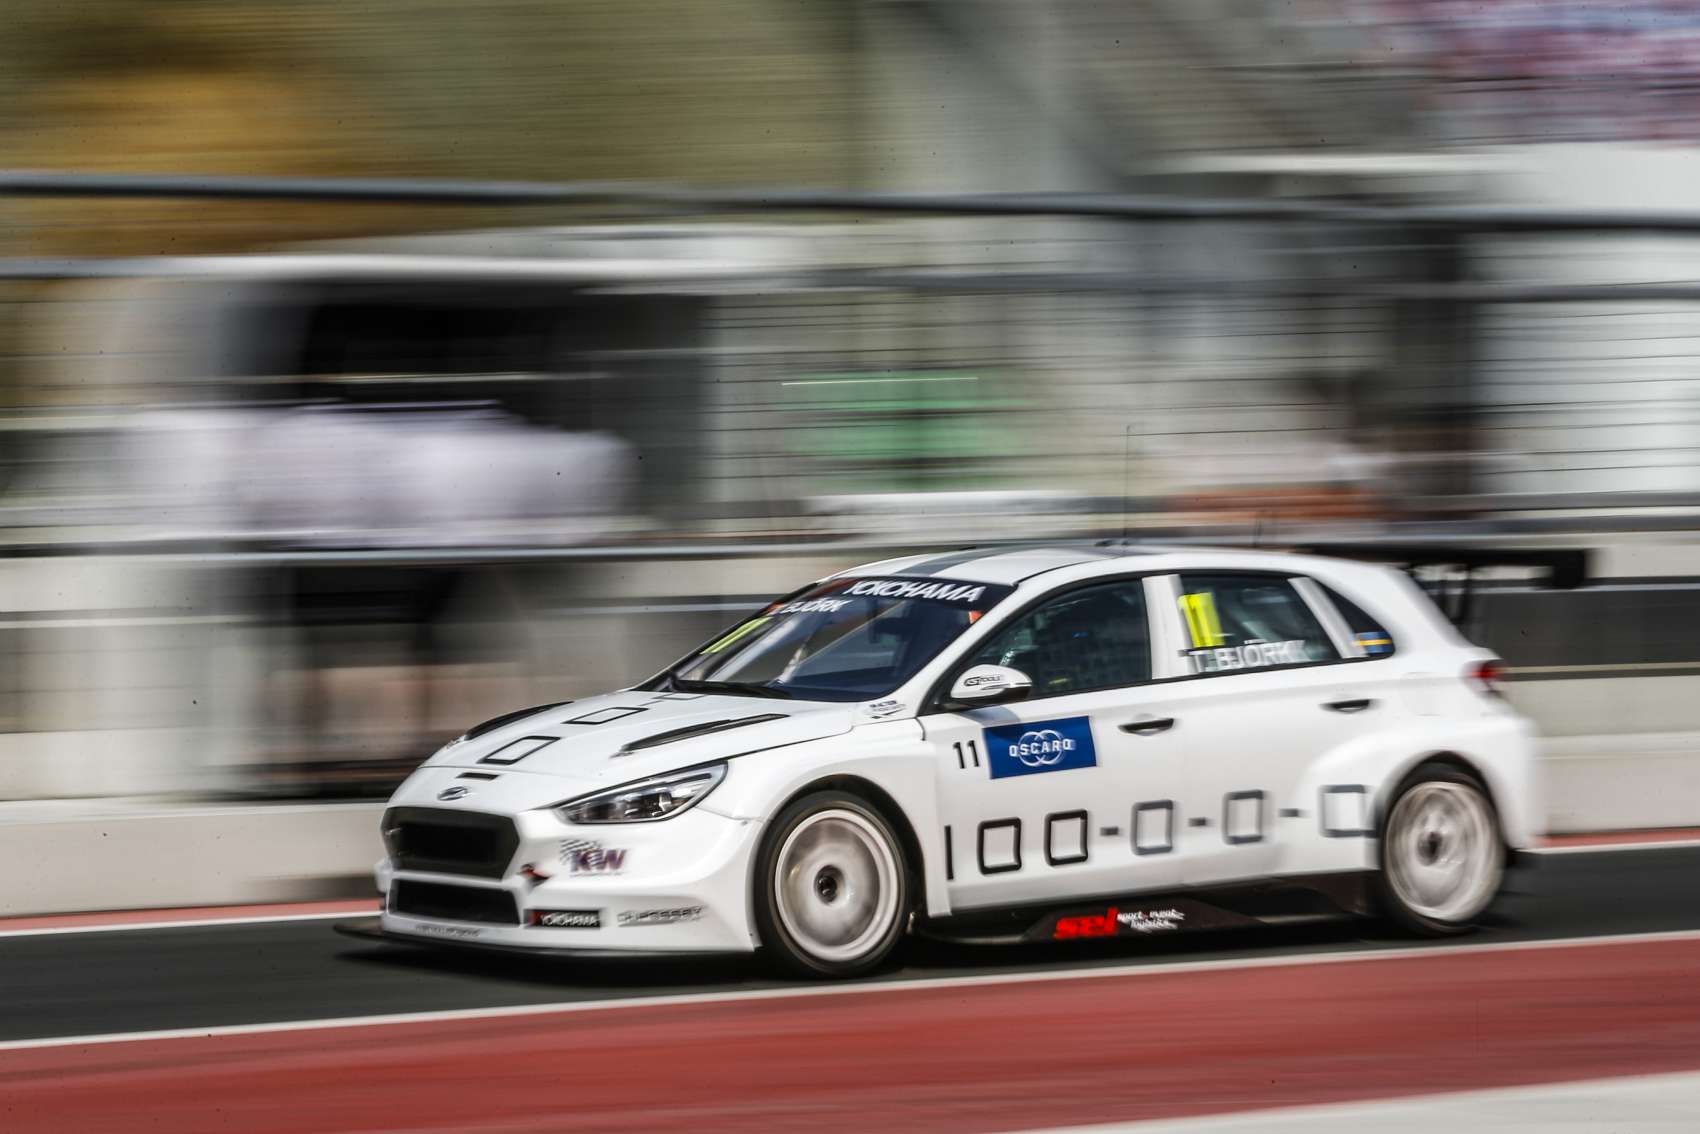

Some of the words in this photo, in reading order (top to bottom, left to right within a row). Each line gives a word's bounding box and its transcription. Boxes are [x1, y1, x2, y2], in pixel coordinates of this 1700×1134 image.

[843, 580, 987, 602] YOKOHAMA
[1179, 592, 1225, 647] 11
[952, 740, 980, 769] 11
[1009, 738, 1076, 757] OSCARO
[570, 848, 627, 872] KW
